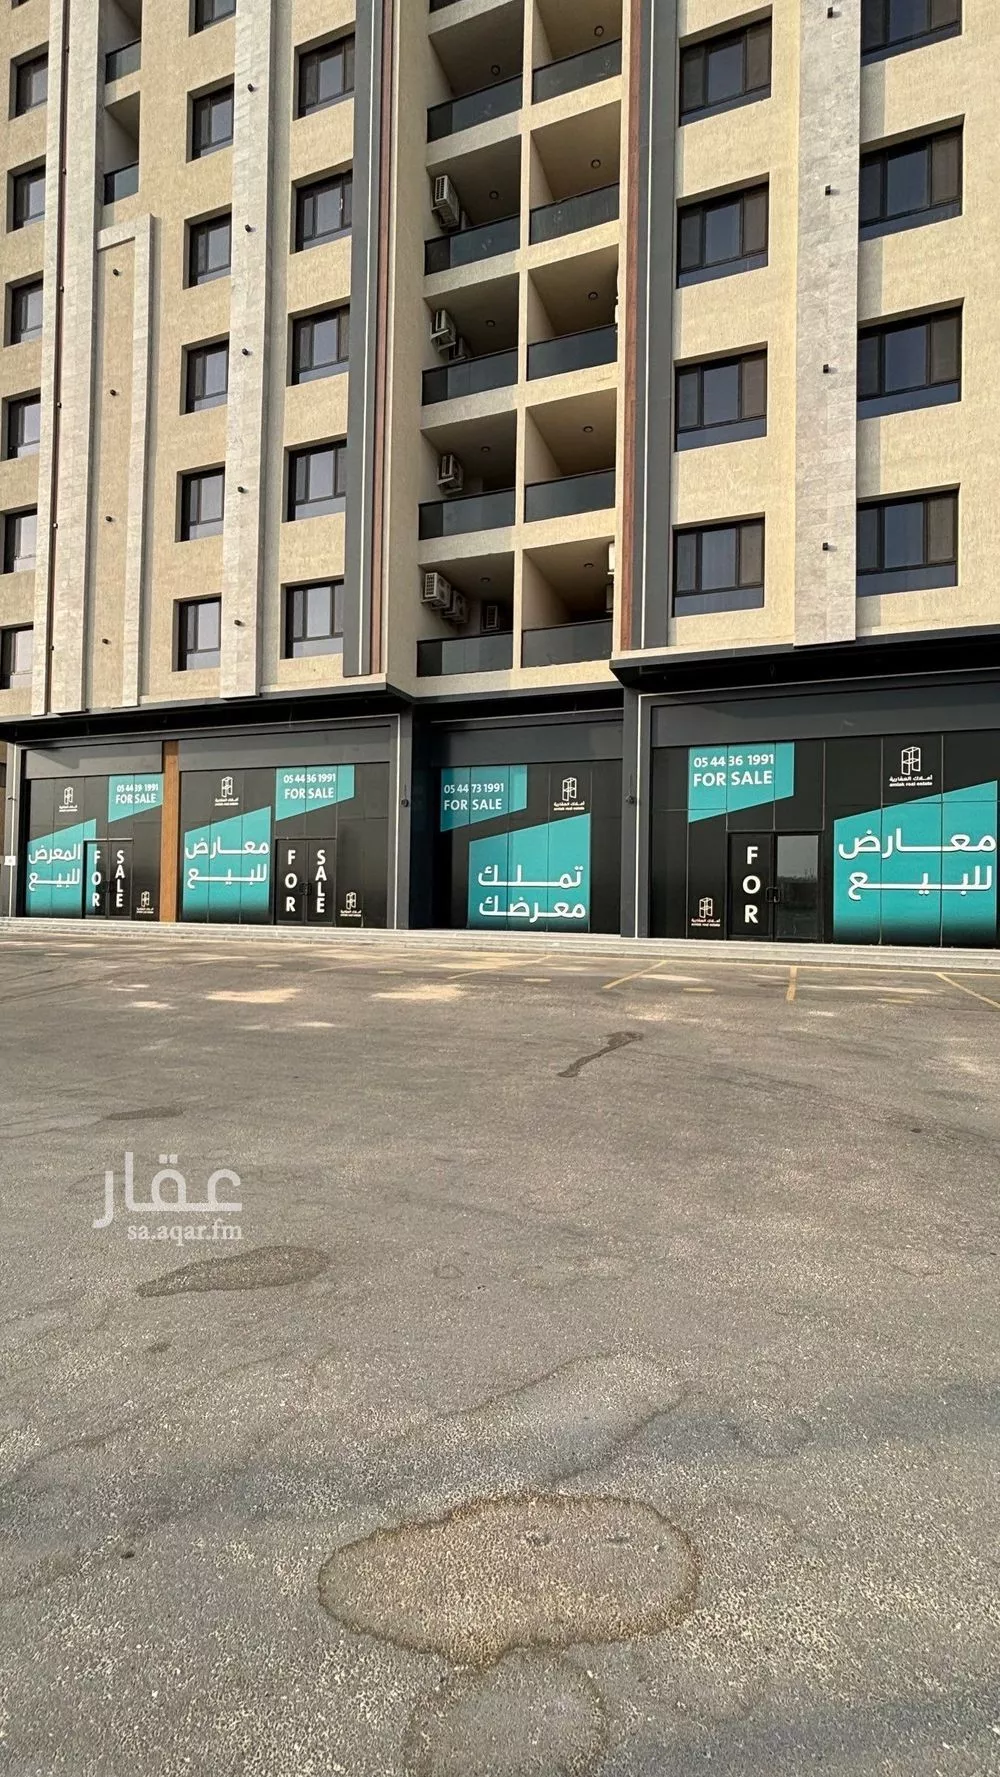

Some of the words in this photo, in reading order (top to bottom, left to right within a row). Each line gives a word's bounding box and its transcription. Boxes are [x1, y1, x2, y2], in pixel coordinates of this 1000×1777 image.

[694, 757, 708, 768] 05
[710, 757, 726, 767] 44
[728, 755, 743, 766] 36
[747, 754, 774, 765] 1991
[283, 774, 294, 783] 05
[294, 774, 305, 783] 44
[306, 773, 316, 782] 36
[317, 773, 336, 782] 1991
[444, 784, 455, 794] 05
[457, 783, 469, 793] 44
[472, 783, 482, 793] 73
[483, 783, 504, 793] 1991
[693, 772, 726, 787] FOR
[731, 770, 772, 785] SALE
[115, 793, 133, 804] FOR
[134, 793, 157, 804] SALE
[284, 788, 305, 799] FOR
[308, 787, 334, 798] SALE
[444, 799, 468, 811] FOR
[472, 798, 502, 810] SALE
[28, 843, 81, 864] المعرض
[184, 835, 270, 859] معارض
[838, 828, 997, 859] معارض
[28, 868, 81, 892] للبيع
[91, 850, 101, 907] FOR
[115, 850, 125, 907] SALE
[187, 863, 267, 889] للبيع
[284, 850, 298, 912] FOR
[315, 850, 327, 913] SALE
[477, 864, 584, 889] تملك
[742, 846, 761, 923] FOR
[848, 865, 993, 901] للبيع
[478, 895, 586, 923] معرضك
